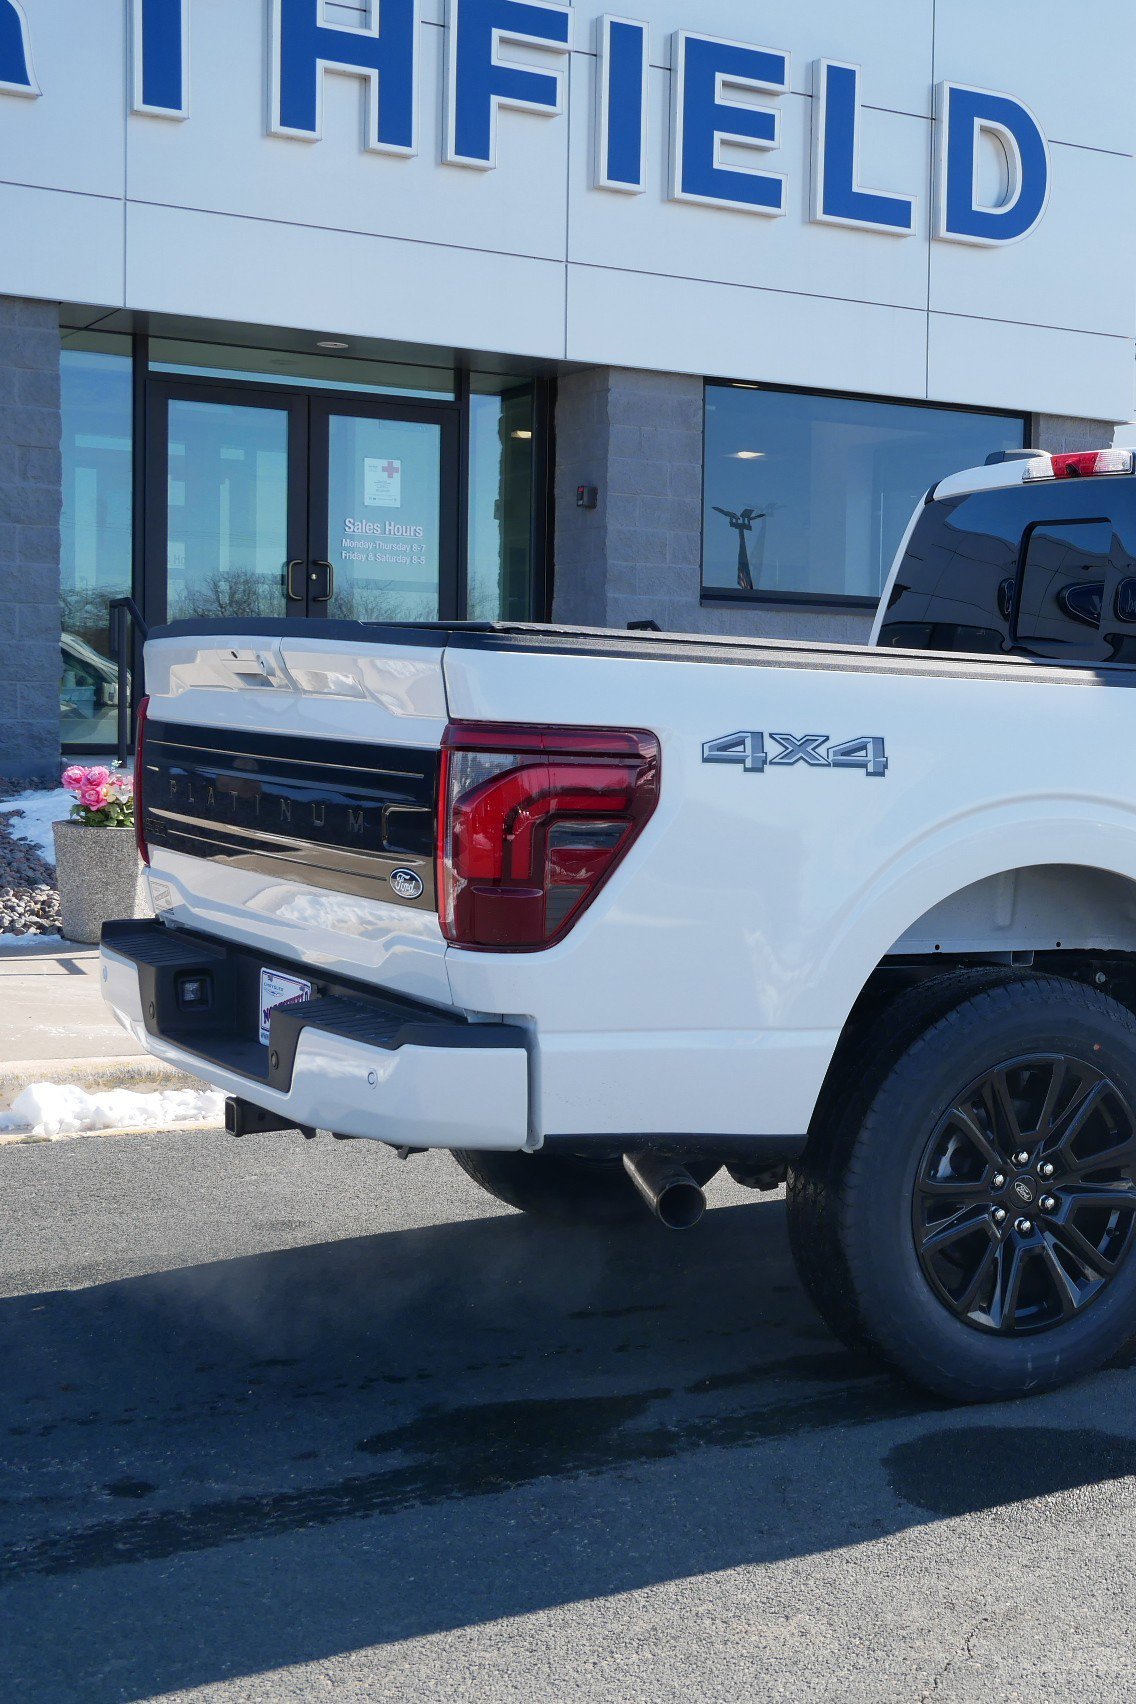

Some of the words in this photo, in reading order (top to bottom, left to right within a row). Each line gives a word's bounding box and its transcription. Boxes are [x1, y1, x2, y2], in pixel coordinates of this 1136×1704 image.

[345, 518, 381, 535] Sales
[385, 520, 423, 537] Hours
[342, 539, 411, 552] Monday-Thursday
[412, 543, 426, 552] 8-7
[342, 551, 366, 562] Friday
[368, 552, 374, 561] &
[376, 552, 411, 564] Saturday
[169, 779, 365, 834] PLATINUM
[394, 872, 416, 894] Ford
